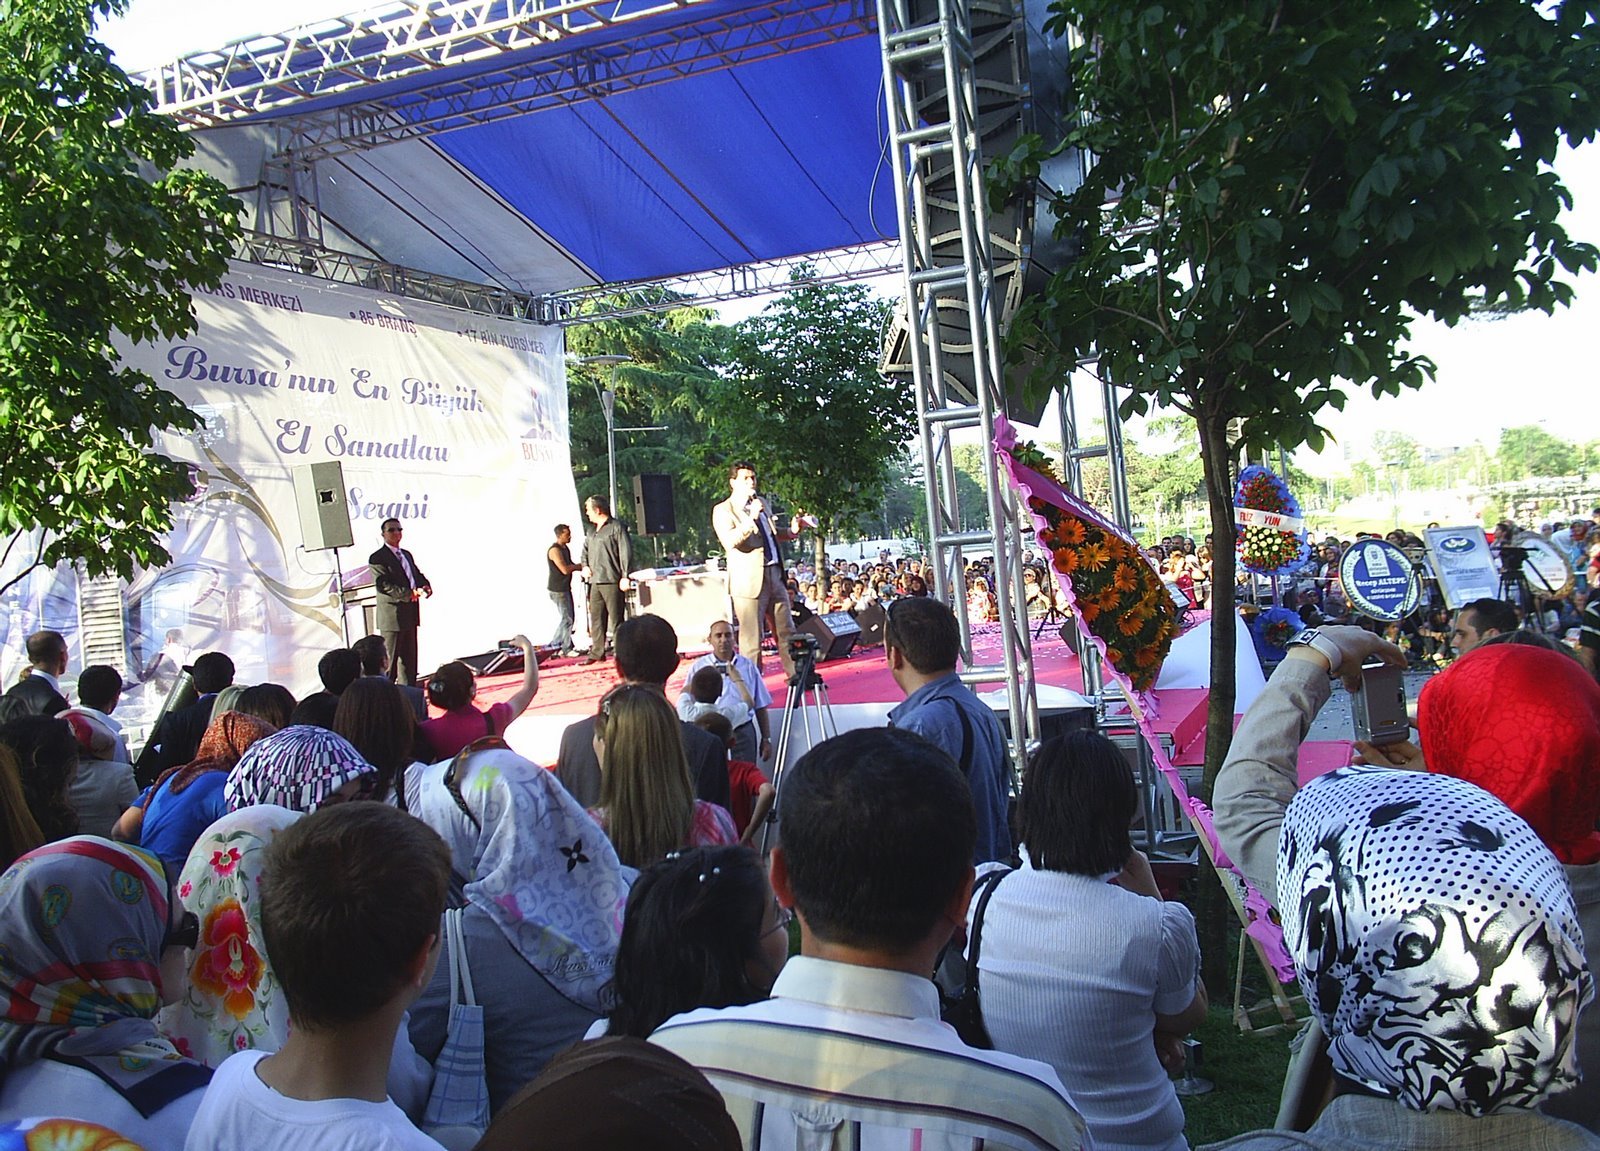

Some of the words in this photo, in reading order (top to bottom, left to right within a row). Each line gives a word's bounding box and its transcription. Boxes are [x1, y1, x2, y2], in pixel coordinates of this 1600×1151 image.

[238, 285, 304, 313] MERKEZİ
[358, 309, 375, 327] 85
[377, 313, 418, 339] BRANŞ
[465, 329, 478, 344] 17
[501, 332, 547, 355] KURSİYER
[164, 345, 339, 395] Bursa'nın
[350, 367, 391, 401] En
[401, 377, 485, 418] Büyük
[275, 418, 313, 455] El
[324, 423, 450, 462] Sanatları
